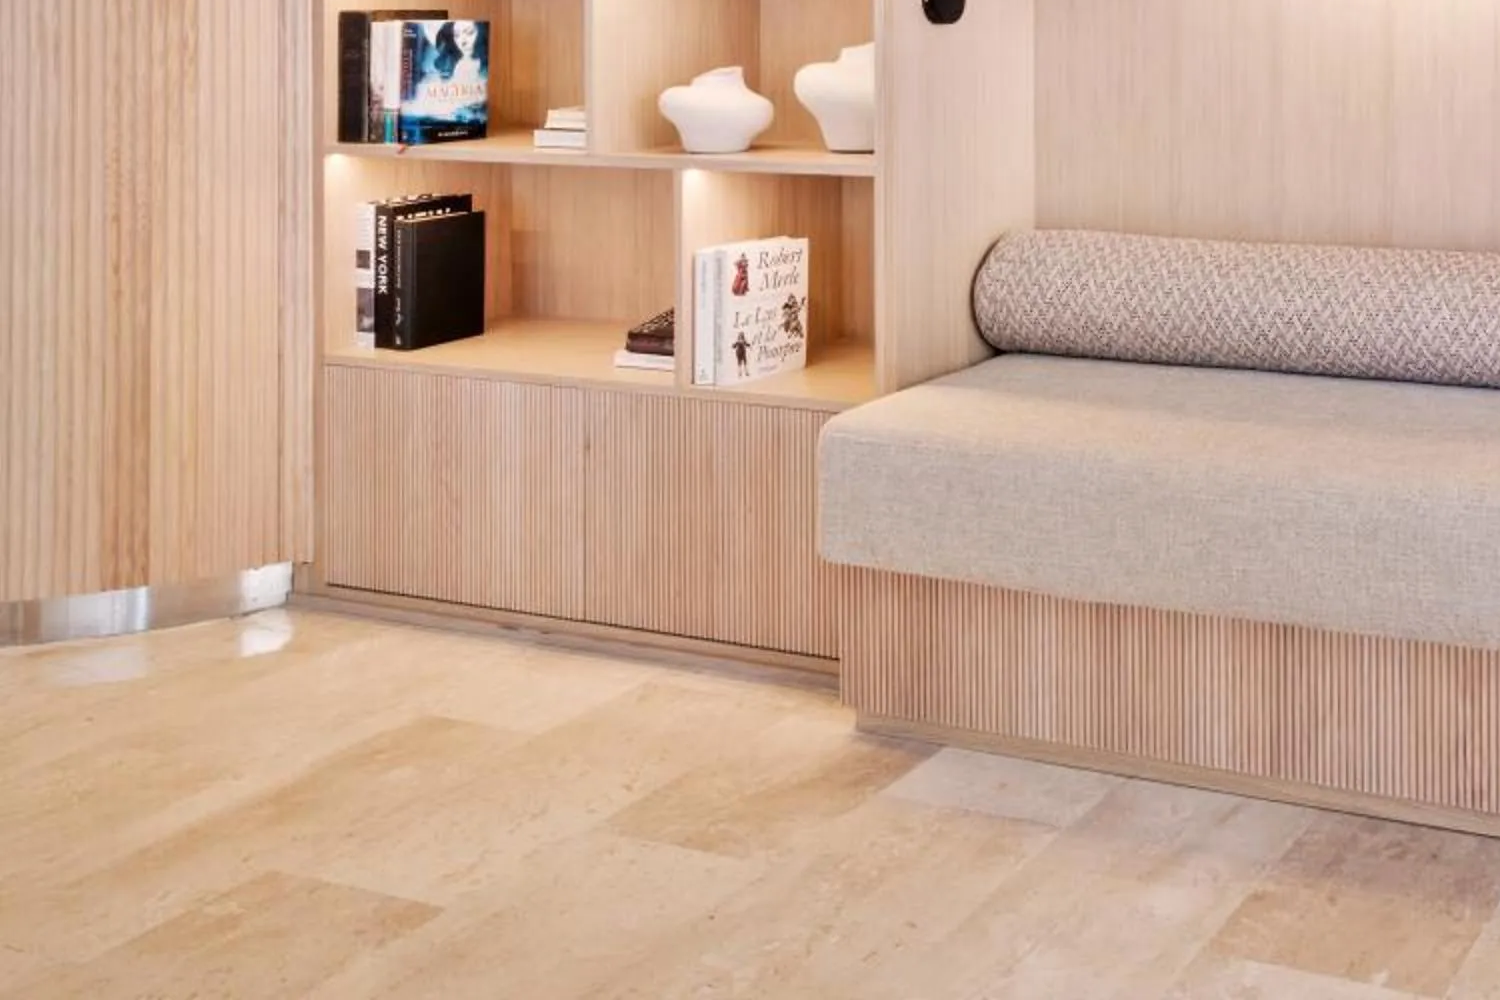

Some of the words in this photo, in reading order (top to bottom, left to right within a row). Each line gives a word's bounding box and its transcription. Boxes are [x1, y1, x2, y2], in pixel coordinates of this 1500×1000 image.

[377, 215, 388, 249] NEW
[756, 248, 803, 270] Robert
[377, 255, 389, 295] YORK
[759, 266, 801, 292] Merle
